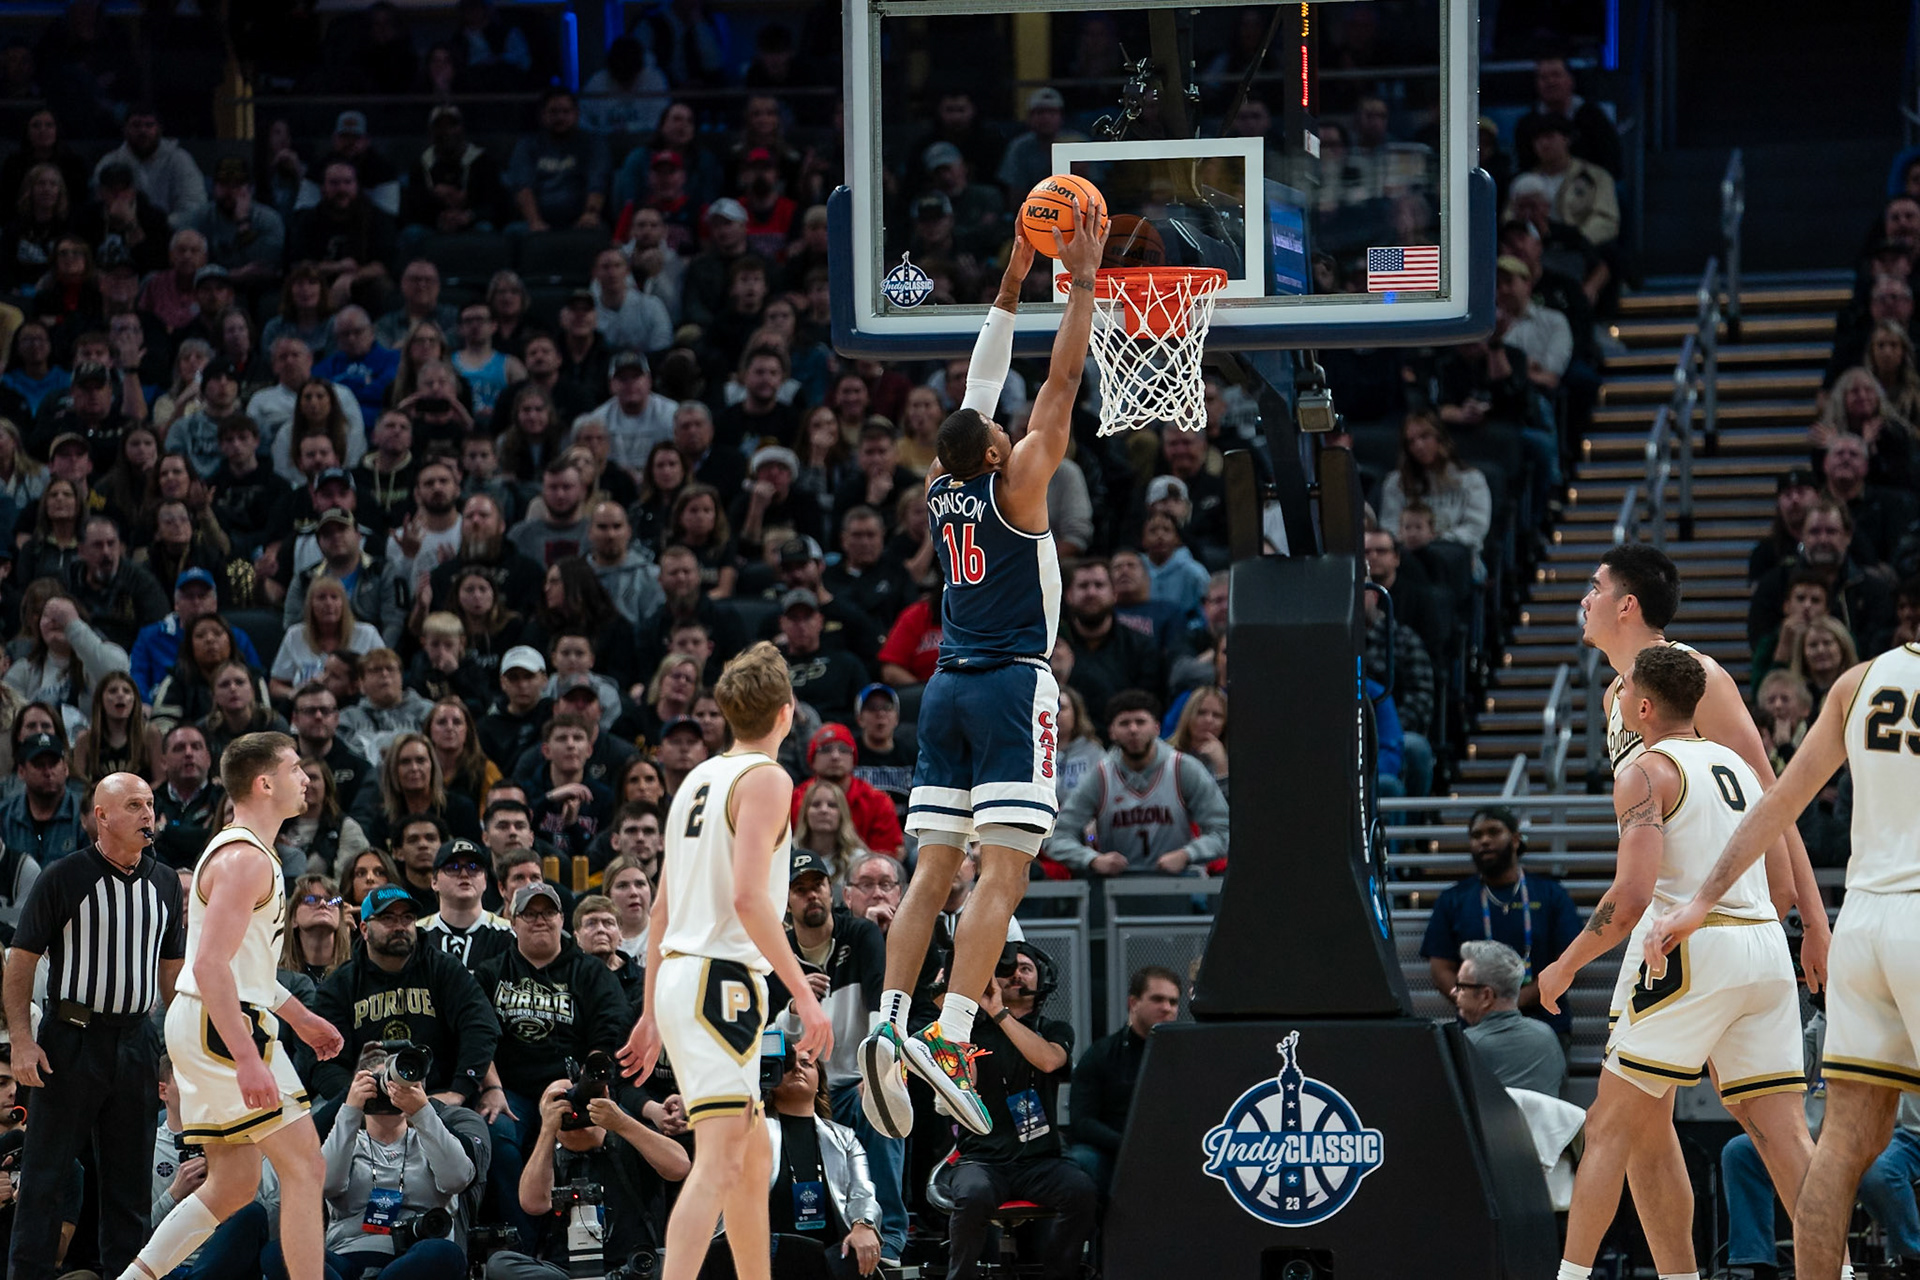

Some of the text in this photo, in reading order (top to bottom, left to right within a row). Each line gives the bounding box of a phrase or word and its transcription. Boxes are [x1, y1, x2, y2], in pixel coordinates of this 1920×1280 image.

[1026, 205, 1060, 221] NCAA
[927, 492, 987, 526] JOHNSON
[943, 523, 986, 584] 16
[1038, 711, 1054, 778] CATS
[1709, 763, 1747, 812] 0
[684, 782, 711, 838] 2
[1112, 804, 1174, 828] ARIZONA
[1136, 829, 1150, 857] 1
[354, 988, 436, 1029] PURDUE
[721, 981, 750, 1022] P
[1285, 1198, 1300, 1210] 23
